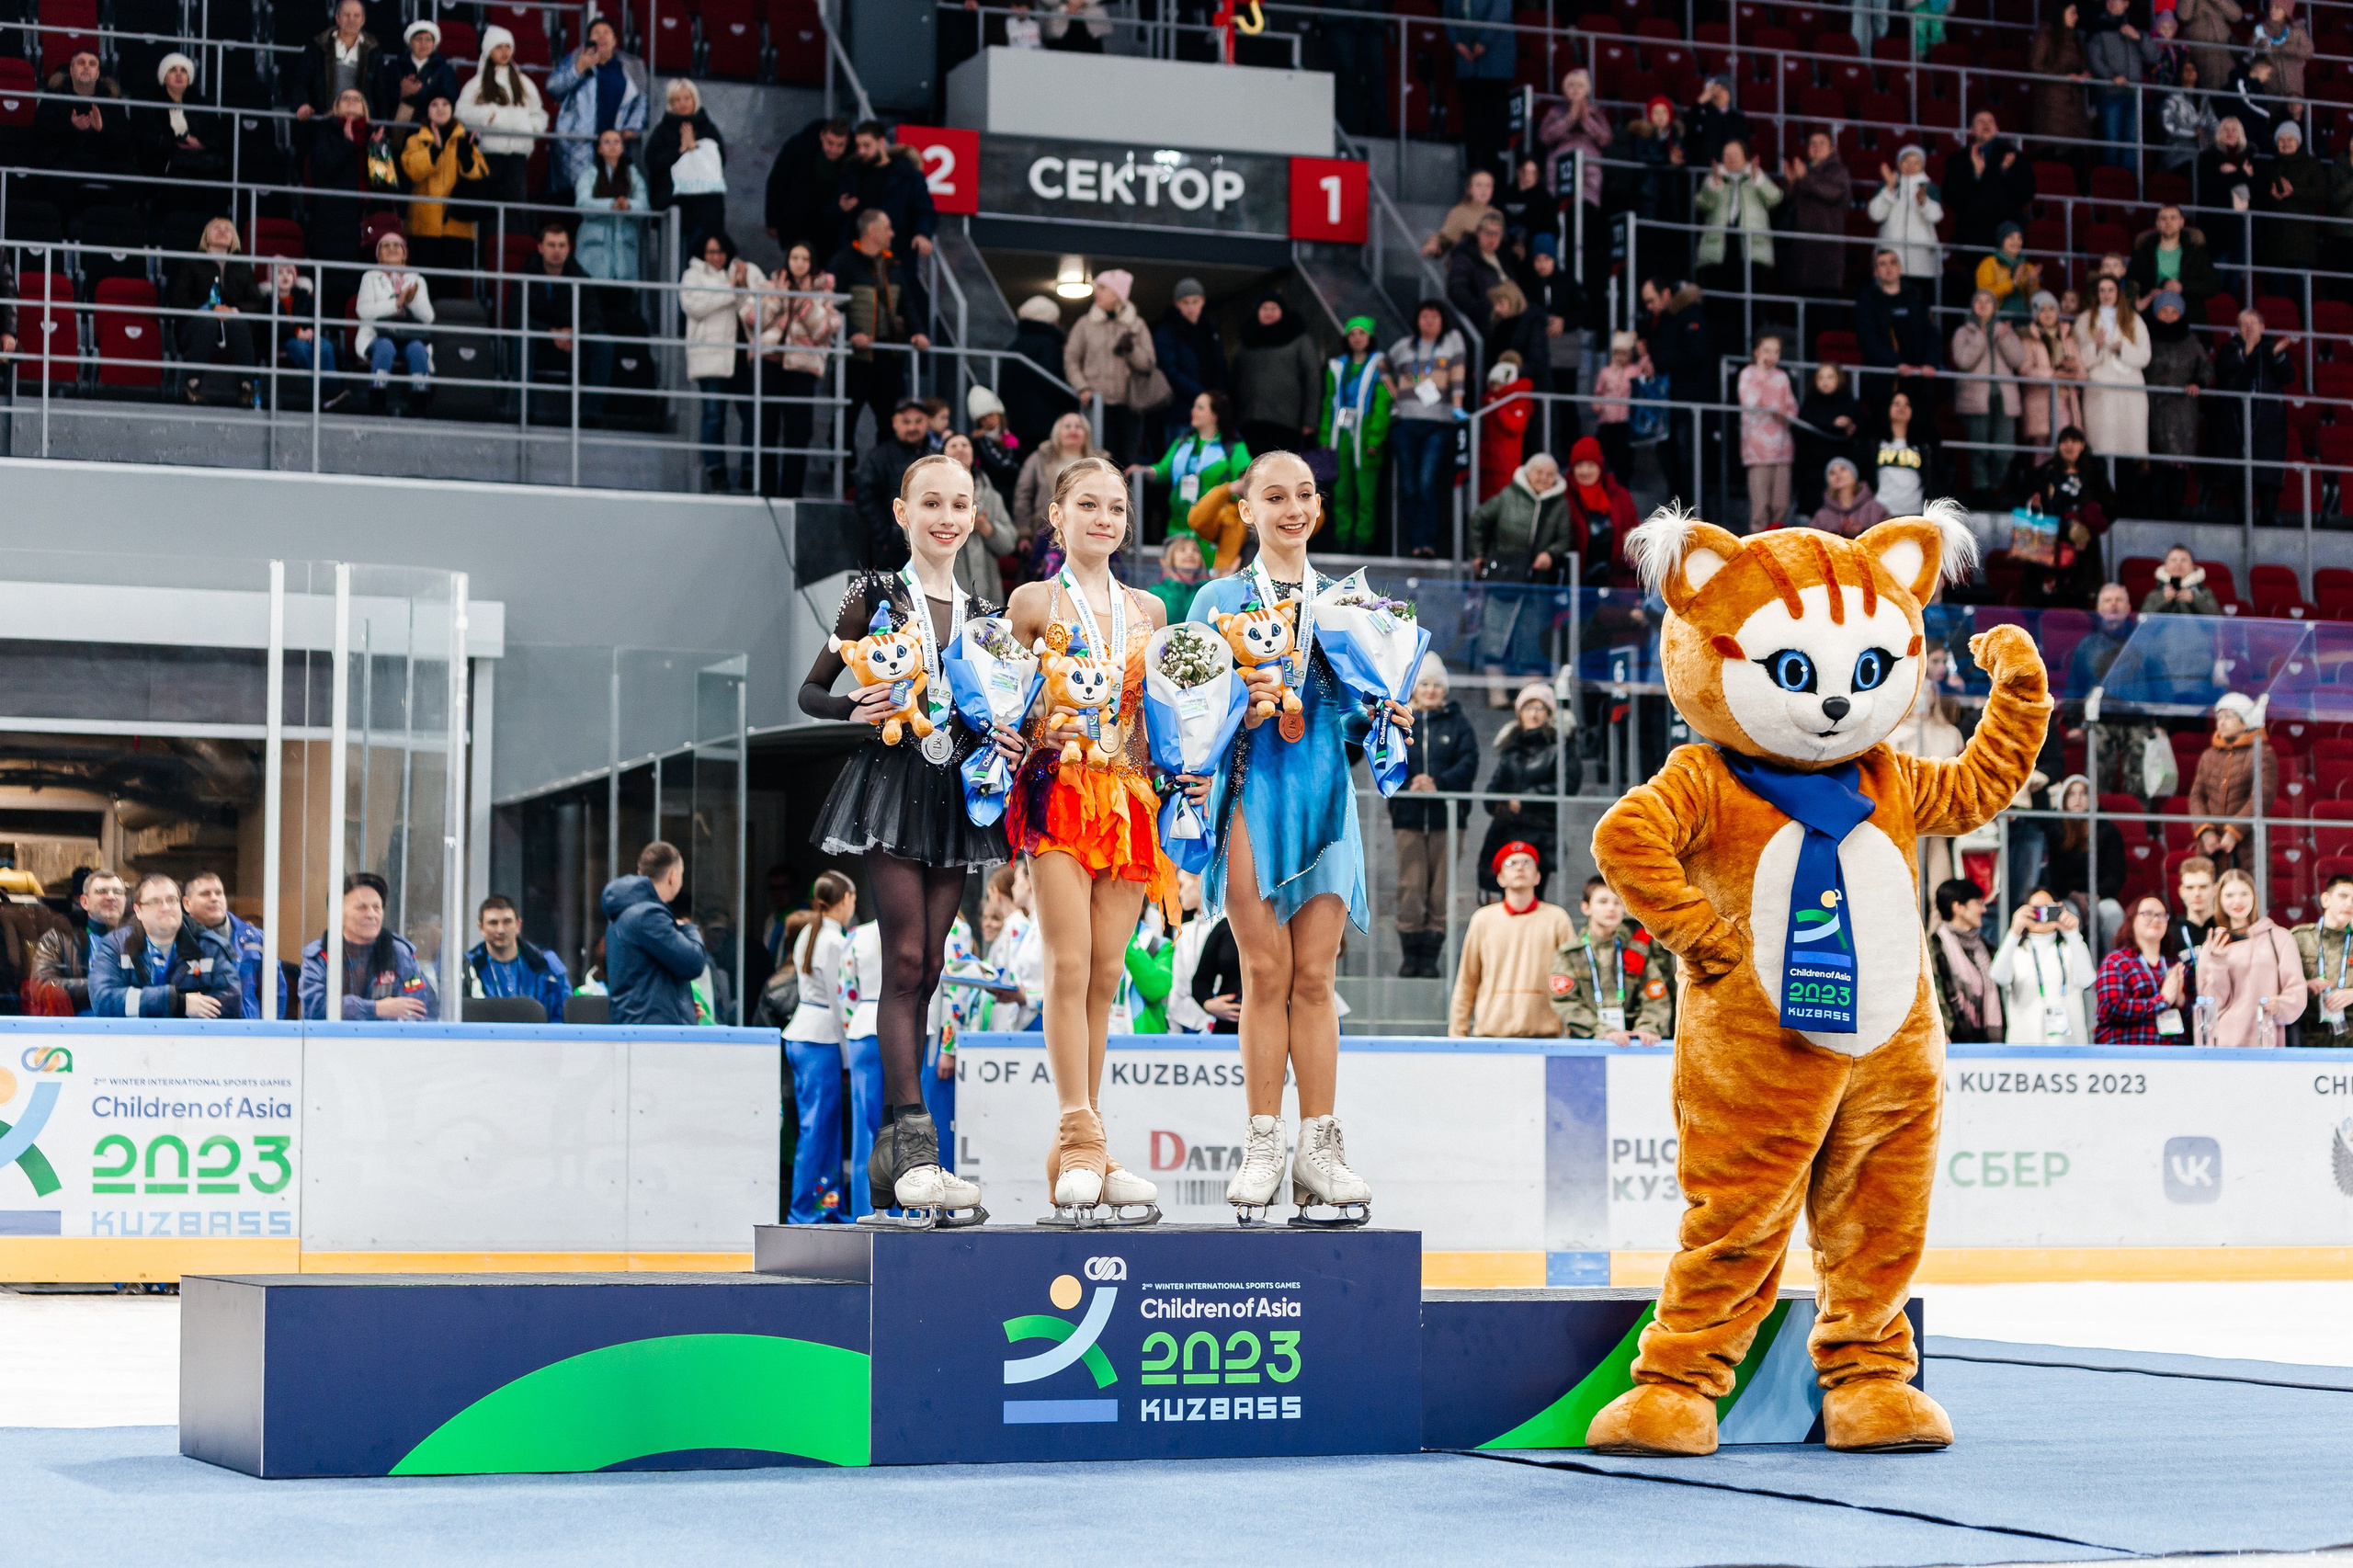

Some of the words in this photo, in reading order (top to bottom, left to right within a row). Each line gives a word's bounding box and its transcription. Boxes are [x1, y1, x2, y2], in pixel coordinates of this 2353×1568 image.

[922, 144, 956, 196] 2
[1028, 155, 1246, 211] СЕКТОР
[1319, 175, 1342, 224] 1
[926, 642, 936, 678] VICTORIES
[1094, 640, 1102, 662] VICTO
[1790, 968, 1825, 978] Children
[1835, 971, 1851, 982] Asia
[1789, 982, 1851, 1006] 2023
[1788, 1007, 1849, 1022] KUZBASS
[109, 1077, 146, 1086] WINTER
[147, 1077, 221, 1086] INTERNATIONAL
[222, 1078, 258, 1087] SPORTS
[259, 1079, 292, 1088] GAMES
[979, 1061, 1020, 1083] OF
[1112, 1062, 1246, 1086] KUZBASS
[1961, 1073, 2078, 1094] KUZBASS
[2087, 1074, 2147, 1095] 2023
[92, 1096, 202, 1119] Children
[207, 1096, 233, 1119] of
[235, 1096, 292, 1119] Asia
[92, 1133, 292, 1195] 2023
[1949, 1150, 2070, 1187] СБЕР
[2170, 1153, 2213, 1187] VK
[92, 1210, 292, 1235] KUZBASS
[1185, 1282, 1245, 1290] INTERNATIONAL
[1245, 1281, 1274, 1290] SPORTS
[1140, 1298, 1230, 1318] Children
[1233, 1297, 1255, 1318] of
[1256, 1297, 1302, 1318] Asia
[1142, 1330, 1302, 1385] 2023
[1141, 1396, 1302, 1422] KUZBASS
